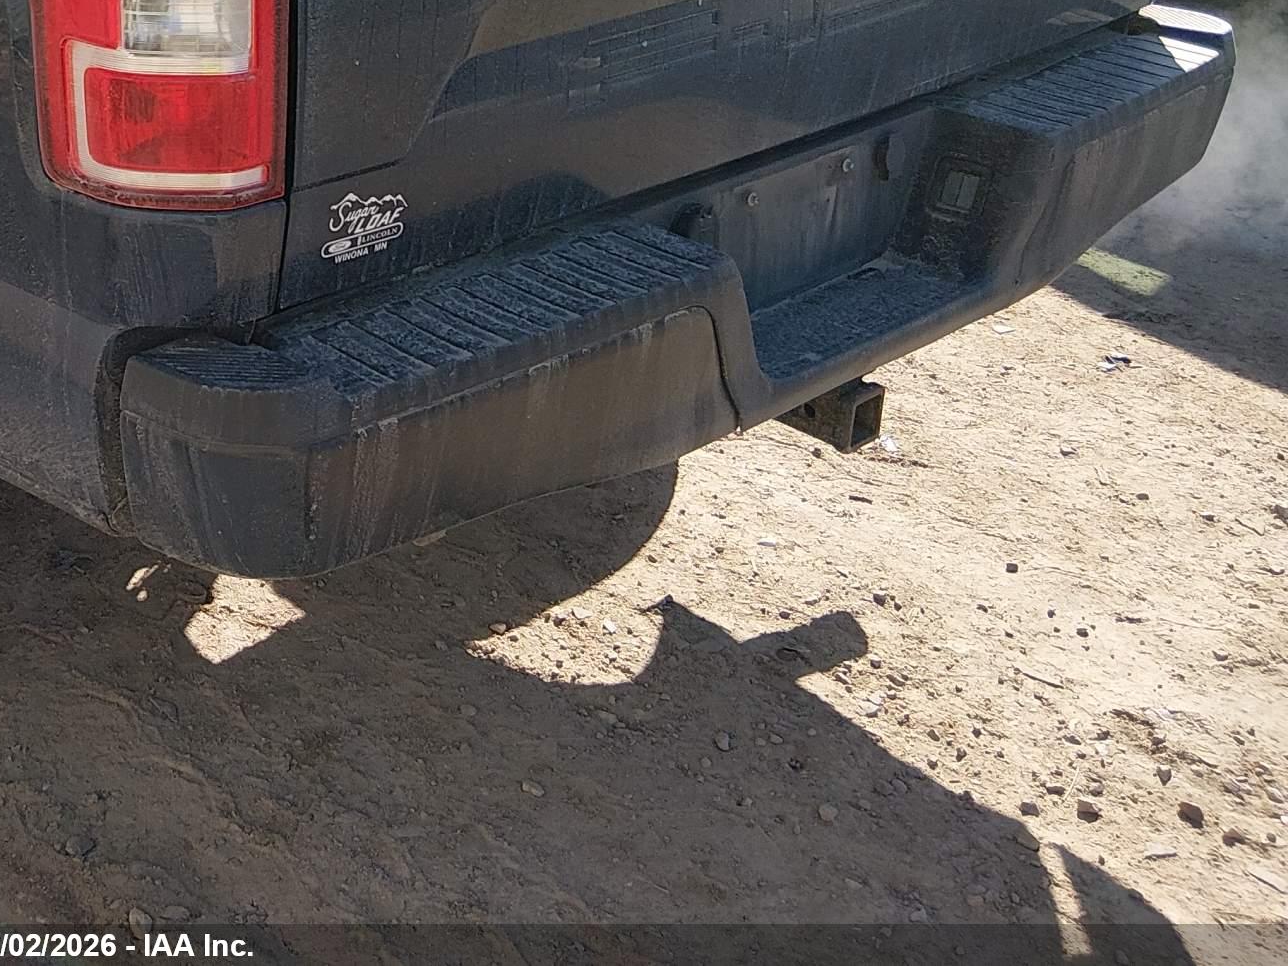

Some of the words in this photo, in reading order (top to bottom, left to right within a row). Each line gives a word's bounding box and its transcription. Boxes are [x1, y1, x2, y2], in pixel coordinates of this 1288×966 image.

[362, 226, 399, 243] LINCOLN
[334, 247, 369, 264] WINONA
[374, 241, 388, 253] MN
